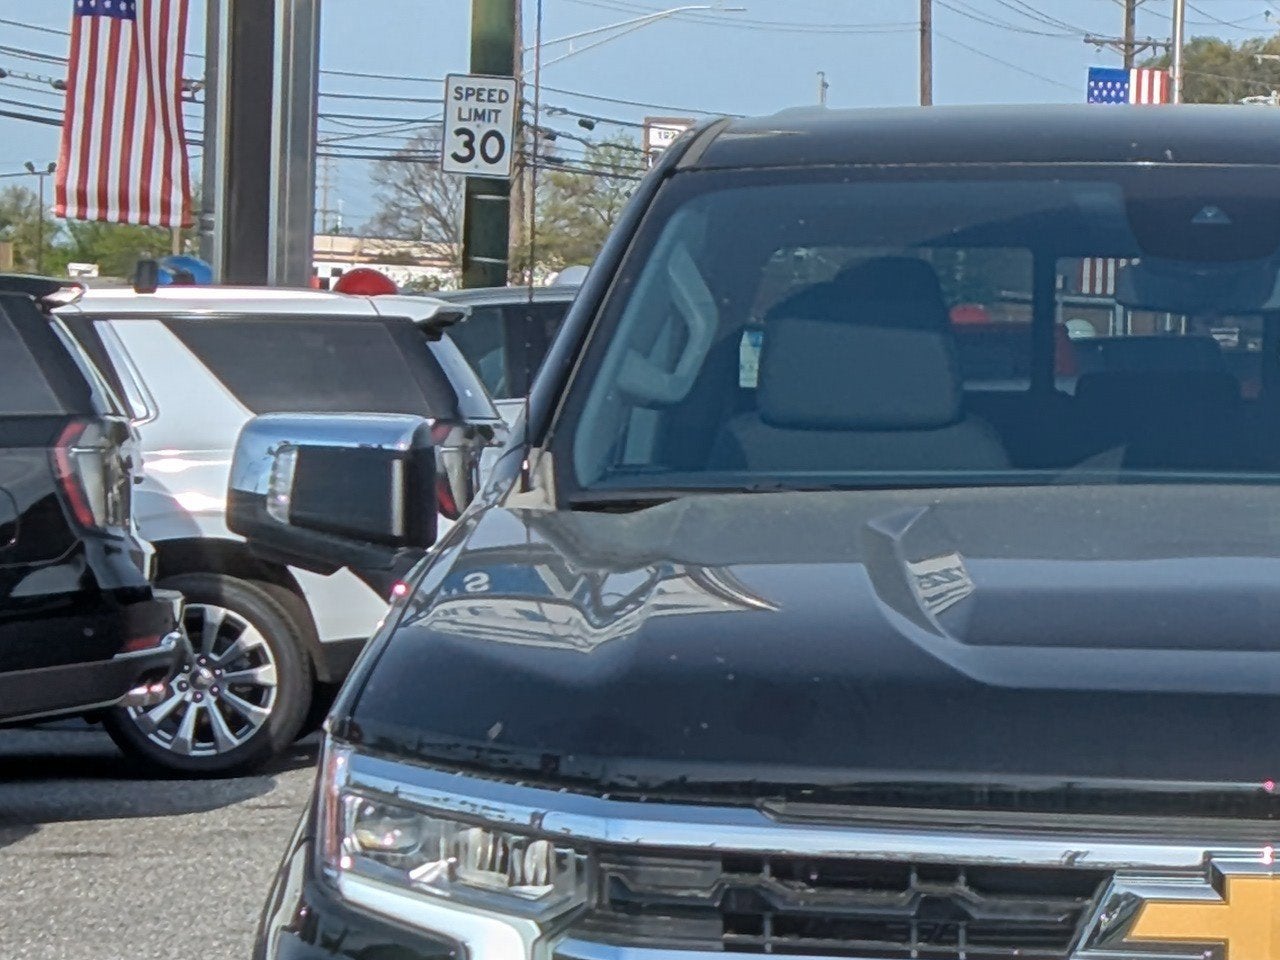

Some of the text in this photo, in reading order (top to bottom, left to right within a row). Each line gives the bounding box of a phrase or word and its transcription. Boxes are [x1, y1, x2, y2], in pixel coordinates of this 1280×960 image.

[453, 86, 510, 104] SPEED
[457, 106, 502, 123] LIMIT
[450, 127, 506, 165] 30
